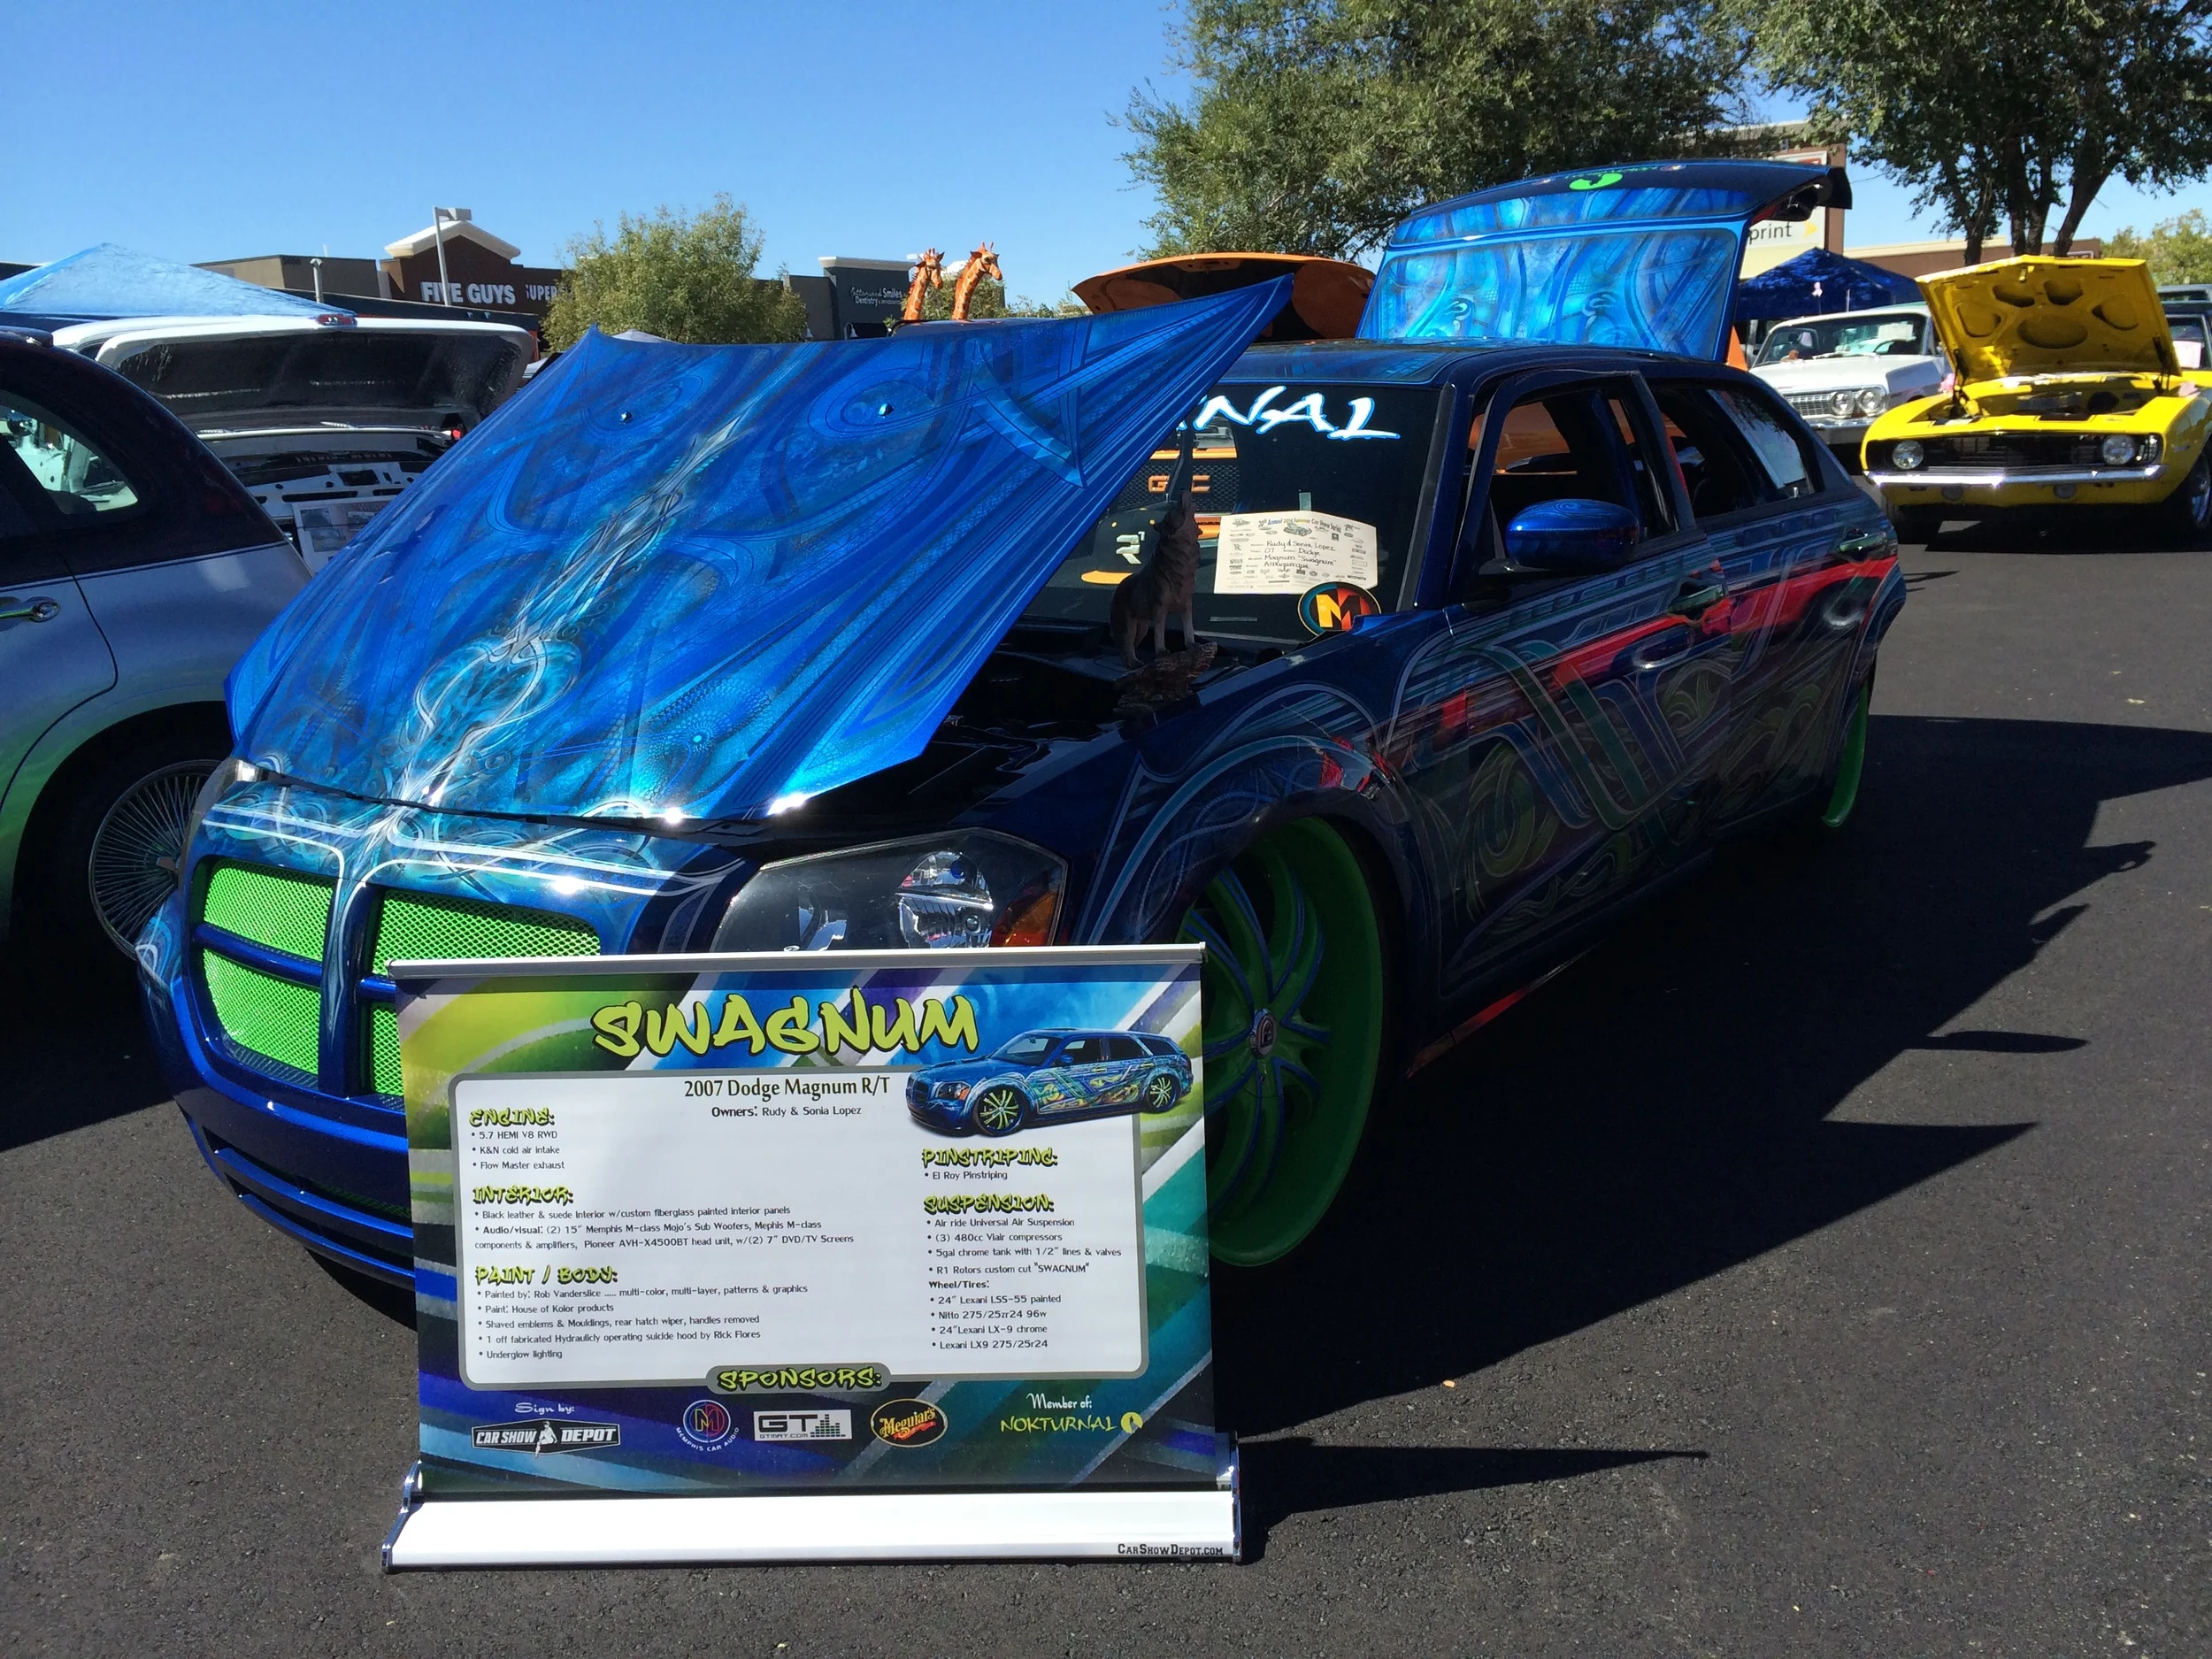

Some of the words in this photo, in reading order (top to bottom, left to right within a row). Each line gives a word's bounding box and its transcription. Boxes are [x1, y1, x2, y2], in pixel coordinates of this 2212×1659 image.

[1748, 221, 1793, 244] print
[466, 283, 516, 304] GUYS
[882, 288, 902, 298] Smiles
[855, 296, 879, 307] Dentistry
[1189, 385, 1401, 441] NAL
[1148, 475, 1210, 493] GC
[1266, 540, 1286, 549] Rudy
[1315, 541, 1335, 551] Lopez
[1298, 548, 1320, 557] Dodge
[1264, 554, 1295, 564] Magnum
[592, 987, 979, 1058] SWAGNUM
[684, 1079, 724, 1097] 2007
[727, 1077, 780, 1101] Dodge
[784, 1078, 857, 1101] Magnum
[861, 1074, 891, 1097] R/T
[469, 1107, 556, 1127] ENGINE:
[710, 1105, 758, 1118] Owners:
[762, 1106, 787, 1118] Rudy
[803, 1106, 830, 1116] Sonia
[833, 1105, 862, 1118] Lopez
[479, 1131, 494, 1140] 5.7
[496, 1131, 519, 1140] HEMI
[521, 1130, 534, 1140] V8
[537, 1130, 558, 1140] RWD
[480, 1146, 500, 1155] K&N
[502, 1146, 519, 1155] cold
[521, 1146, 533, 1155] air
[534, 1145, 561, 1155] intake
[921, 1147, 1058, 1168] PINSTRIPING:
[480, 1161, 499, 1170] Flow
[502, 1161, 531, 1170] Master
[533, 1161, 565, 1170] exhaust
[943, 1171, 961, 1181] Roy
[963, 1171, 1008, 1181] Pinstriping
[472, 1185, 574, 1206] INTERIOR:
[924, 1194, 1055, 1215] SUSPENSION:
[482, 1210, 505, 1219] Black
[507, 1210, 535, 1219] leather
[548, 1210, 572, 1219] suede
[575, 1210, 606, 1219] Interior
[608, 1209, 651, 1218] w/custom
[654, 1208, 695, 1218] fiberglass
[697, 1207, 728, 1218] painted
[730, 1206, 761, 1216] interior
[764, 1205, 791, 1217] panels
[482, 1225, 543, 1234] Audio/visual:
[586, 1225, 623, 1235] Memphis
[625, 1224, 661, 1233] M-class
[694, 1222, 711, 1232] Sub
[713, 1222, 752, 1232] Woofers,
[754, 1220, 785, 1232] Mephis
[787, 1220, 822, 1229] M-class
[933, 1218, 948, 1227] Air
[949, 1218, 967, 1227] ride
[969, 1217, 1009, 1227] Universal
[1011, 1217, 1025, 1226] Air
[1026, 1217, 1075, 1228] Suspension
[474, 1240, 523, 1251] components
[535, 1240, 578, 1251] amplifiers,
[583, 1240, 616, 1248] Pioneer
[618, 1237, 689, 1248] AVH-X4500BT
[691, 1237, 712, 1246] head
[714, 1236, 733, 1247] unit,
[781, 1234, 818, 1244] DVD/TV
[820, 1234, 855, 1243] Screens
[954, 1233, 984, 1242] 480cc
[986, 1233, 1006, 1241] Viair
[1008, 1234, 1063, 1243] compressors
[935, 1248, 956, 1259] 5gal
[957, 1248, 989, 1257] chrome
[992, 1248, 1012, 1256] tank
[1014, 1247, 1033, 1256] with
[1062, 1247, 1082, 1256] lines
[1095, 1248, 1122, 1256] valves
[475, 1265, 535, 1286] PAINT
[557, 1265, 618, 1285] BODY:
[936, 1265, 949, 1275] R1
[952, 1265, 982, 1274] Rotors
[984, 1264, 1016, 1274] custom
[1018, 1264, 1032, 1273] cut
[928, 1279, 990, 1289] Wheel/Tires:
[484, 1290, 515, 1299] Painted
[517, 1290, 531, 1301] by:
[534, 1290, 551, 1299] Rob
[552, 1288, 602, 1298] Vanderslice
[618, 1287, 669, 1297] multi-color,
[671, 1286, 721, 1296] multi-layer,
[723, 1286, 759, 1296] patterns
[772, 1284, 809, 1295] graphics
[959, 1295, 988, 1305] Lexani
[990, 1294, 1027, 1304] LSS-55
[1030, 1294, 1062, 1305] painted
[485, 1305, 509, 1314] Paint:
[511, 1305, 538, 1314] House
[551, 1304, 574, 1313] Kolor
[577, 1303, 615, 1315] products
[938, 1310, 960, 1320] Nitto
[962, 1310, 1023, 1319] 275/25zr24
[1025, 1309, 1048, 1318] 96w
[485, 1320, 515, 1329] Shaved
[517, 1319, 554, 1329] emblems
[567, 1318, 612, 1329] Mouldings,
[634, 1317, 659, 1326] hatch
[661, 1317, 687, 1327] wiper,
[689, 1316, 721, 1325] handles
[724, 1314, 760, 1324] removed
[987, 1325, 1013, 1334] LX-9
[1016, 1325, 1048, 1333] chrome
[495, 1335, 508, 1344] off
[510, 1334, 552, 1344] fabricated
[555, 1333, 601, 1345] Hydraulicly
[603, 1333, 643, 1343] operating
[645, 1332, 674, 1340] suicide
[676, 1331, 697, 1340] hood
[713, 1330, 733, 1340] Rick
[734, 1330, 761, 1339] Flores
[939, 1340, 968, 1349] Lexani
[970, 1340, 989, 1349] LX9
[992, 1339, 1048, 1349] 275/25r24
[486, 1350, 530, 1361] Underglow
[532, 1349, 563, 1360] lighting
[717, 1367, 882, 1390] SPONSORS:
[1026, 1393, 1078, 1409] Member
[1079, 1394, 1093, 1409] of:
[514, 1402, 555, 1416] Sign
[558, 1403, 575, 1414] by:
[879, 1407, 938, 1439] Meguiar's
[1000, 1415, 1118, 1433] NOKTURNAL
[476, 1431, 500, 1444] CAR
[501, 1431, 537, 1443] SHOW
[561, 1429, 617, 1442] DEPOT
[676, 1427, 704, 1451] MEMPHIS
[724, 1427, 740, 1447] AUDIO
